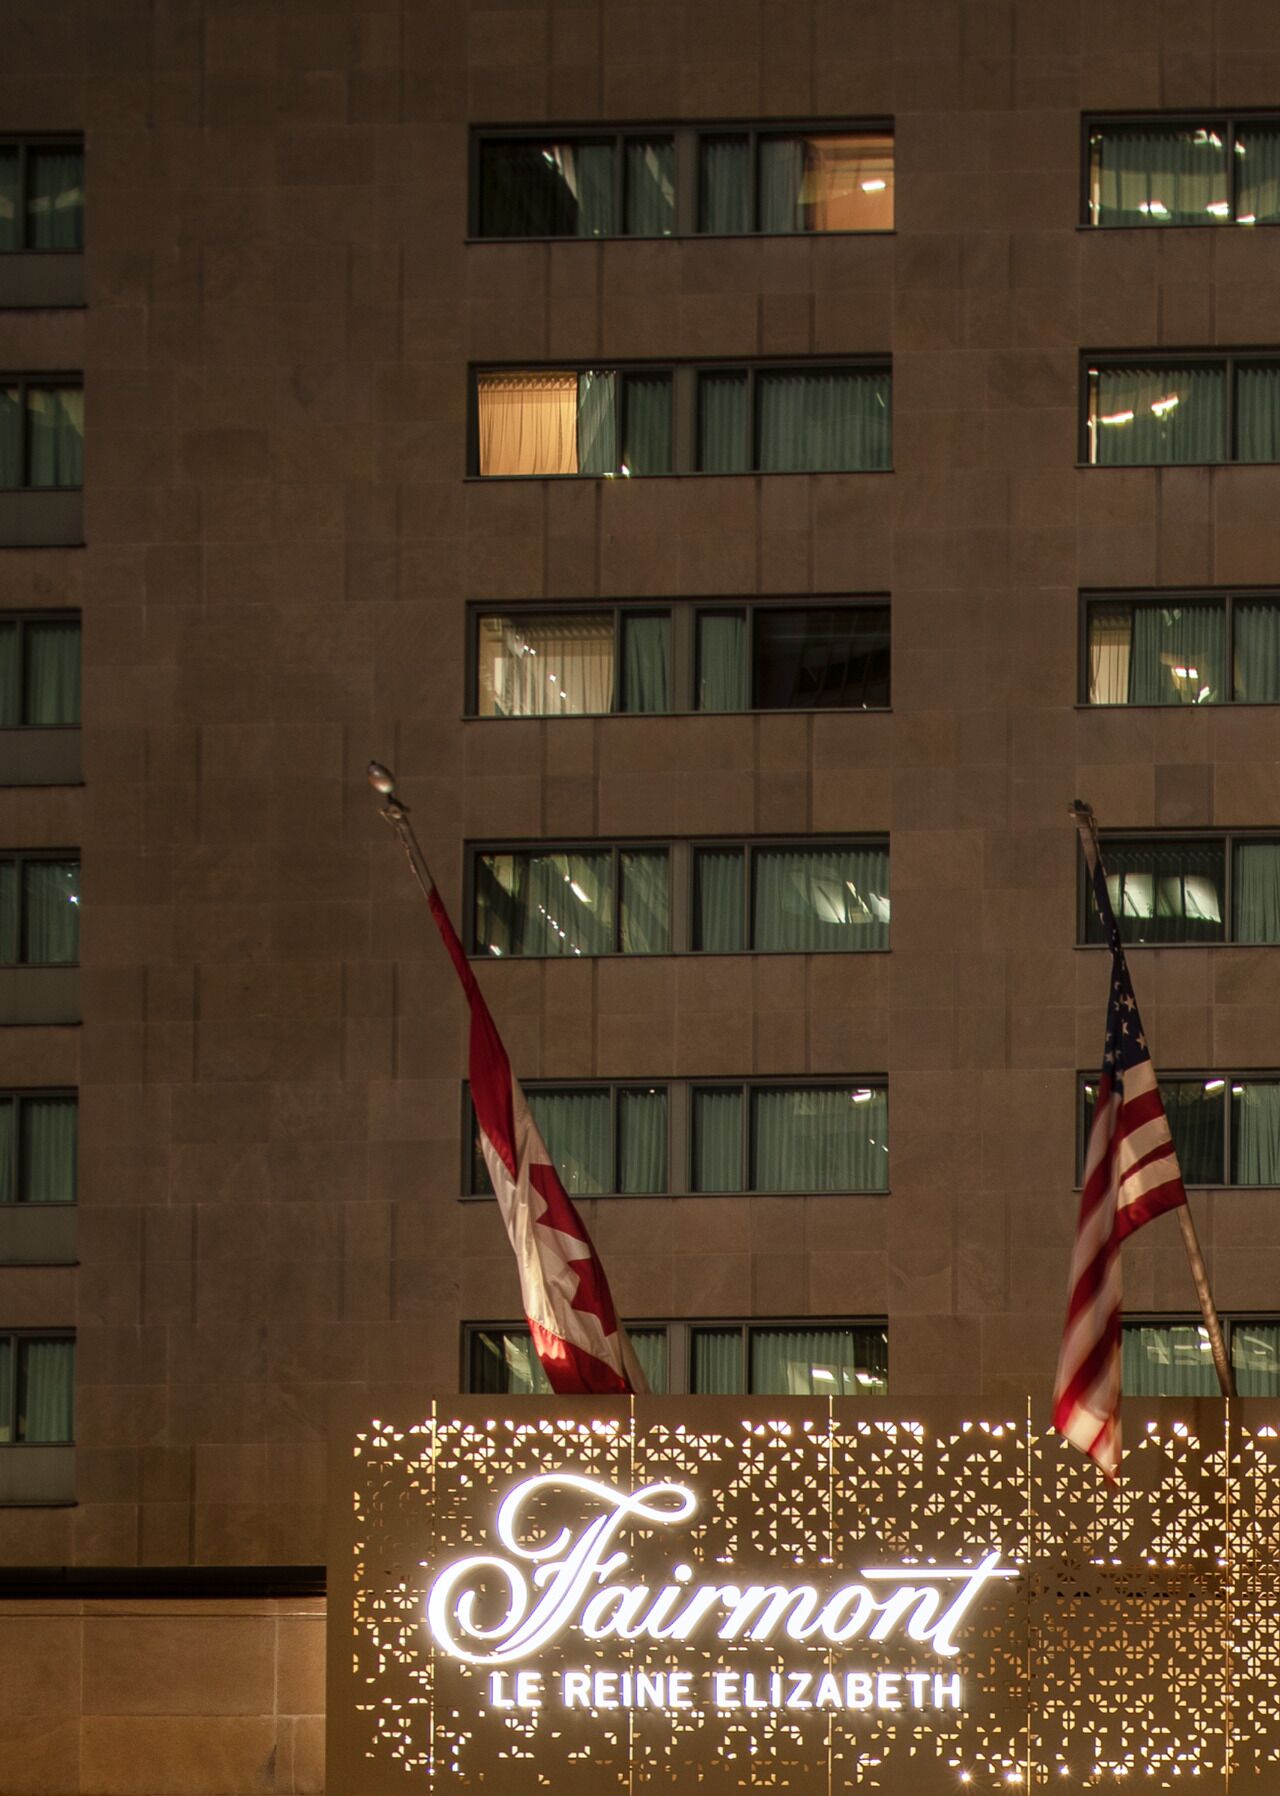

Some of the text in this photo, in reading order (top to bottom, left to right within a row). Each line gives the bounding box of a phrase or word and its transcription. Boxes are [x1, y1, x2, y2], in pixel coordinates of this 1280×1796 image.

[427, 1473, 1020, 1664] Fairmont
[490, 1671, 960, 1710] LE REINE ELIZABETH
